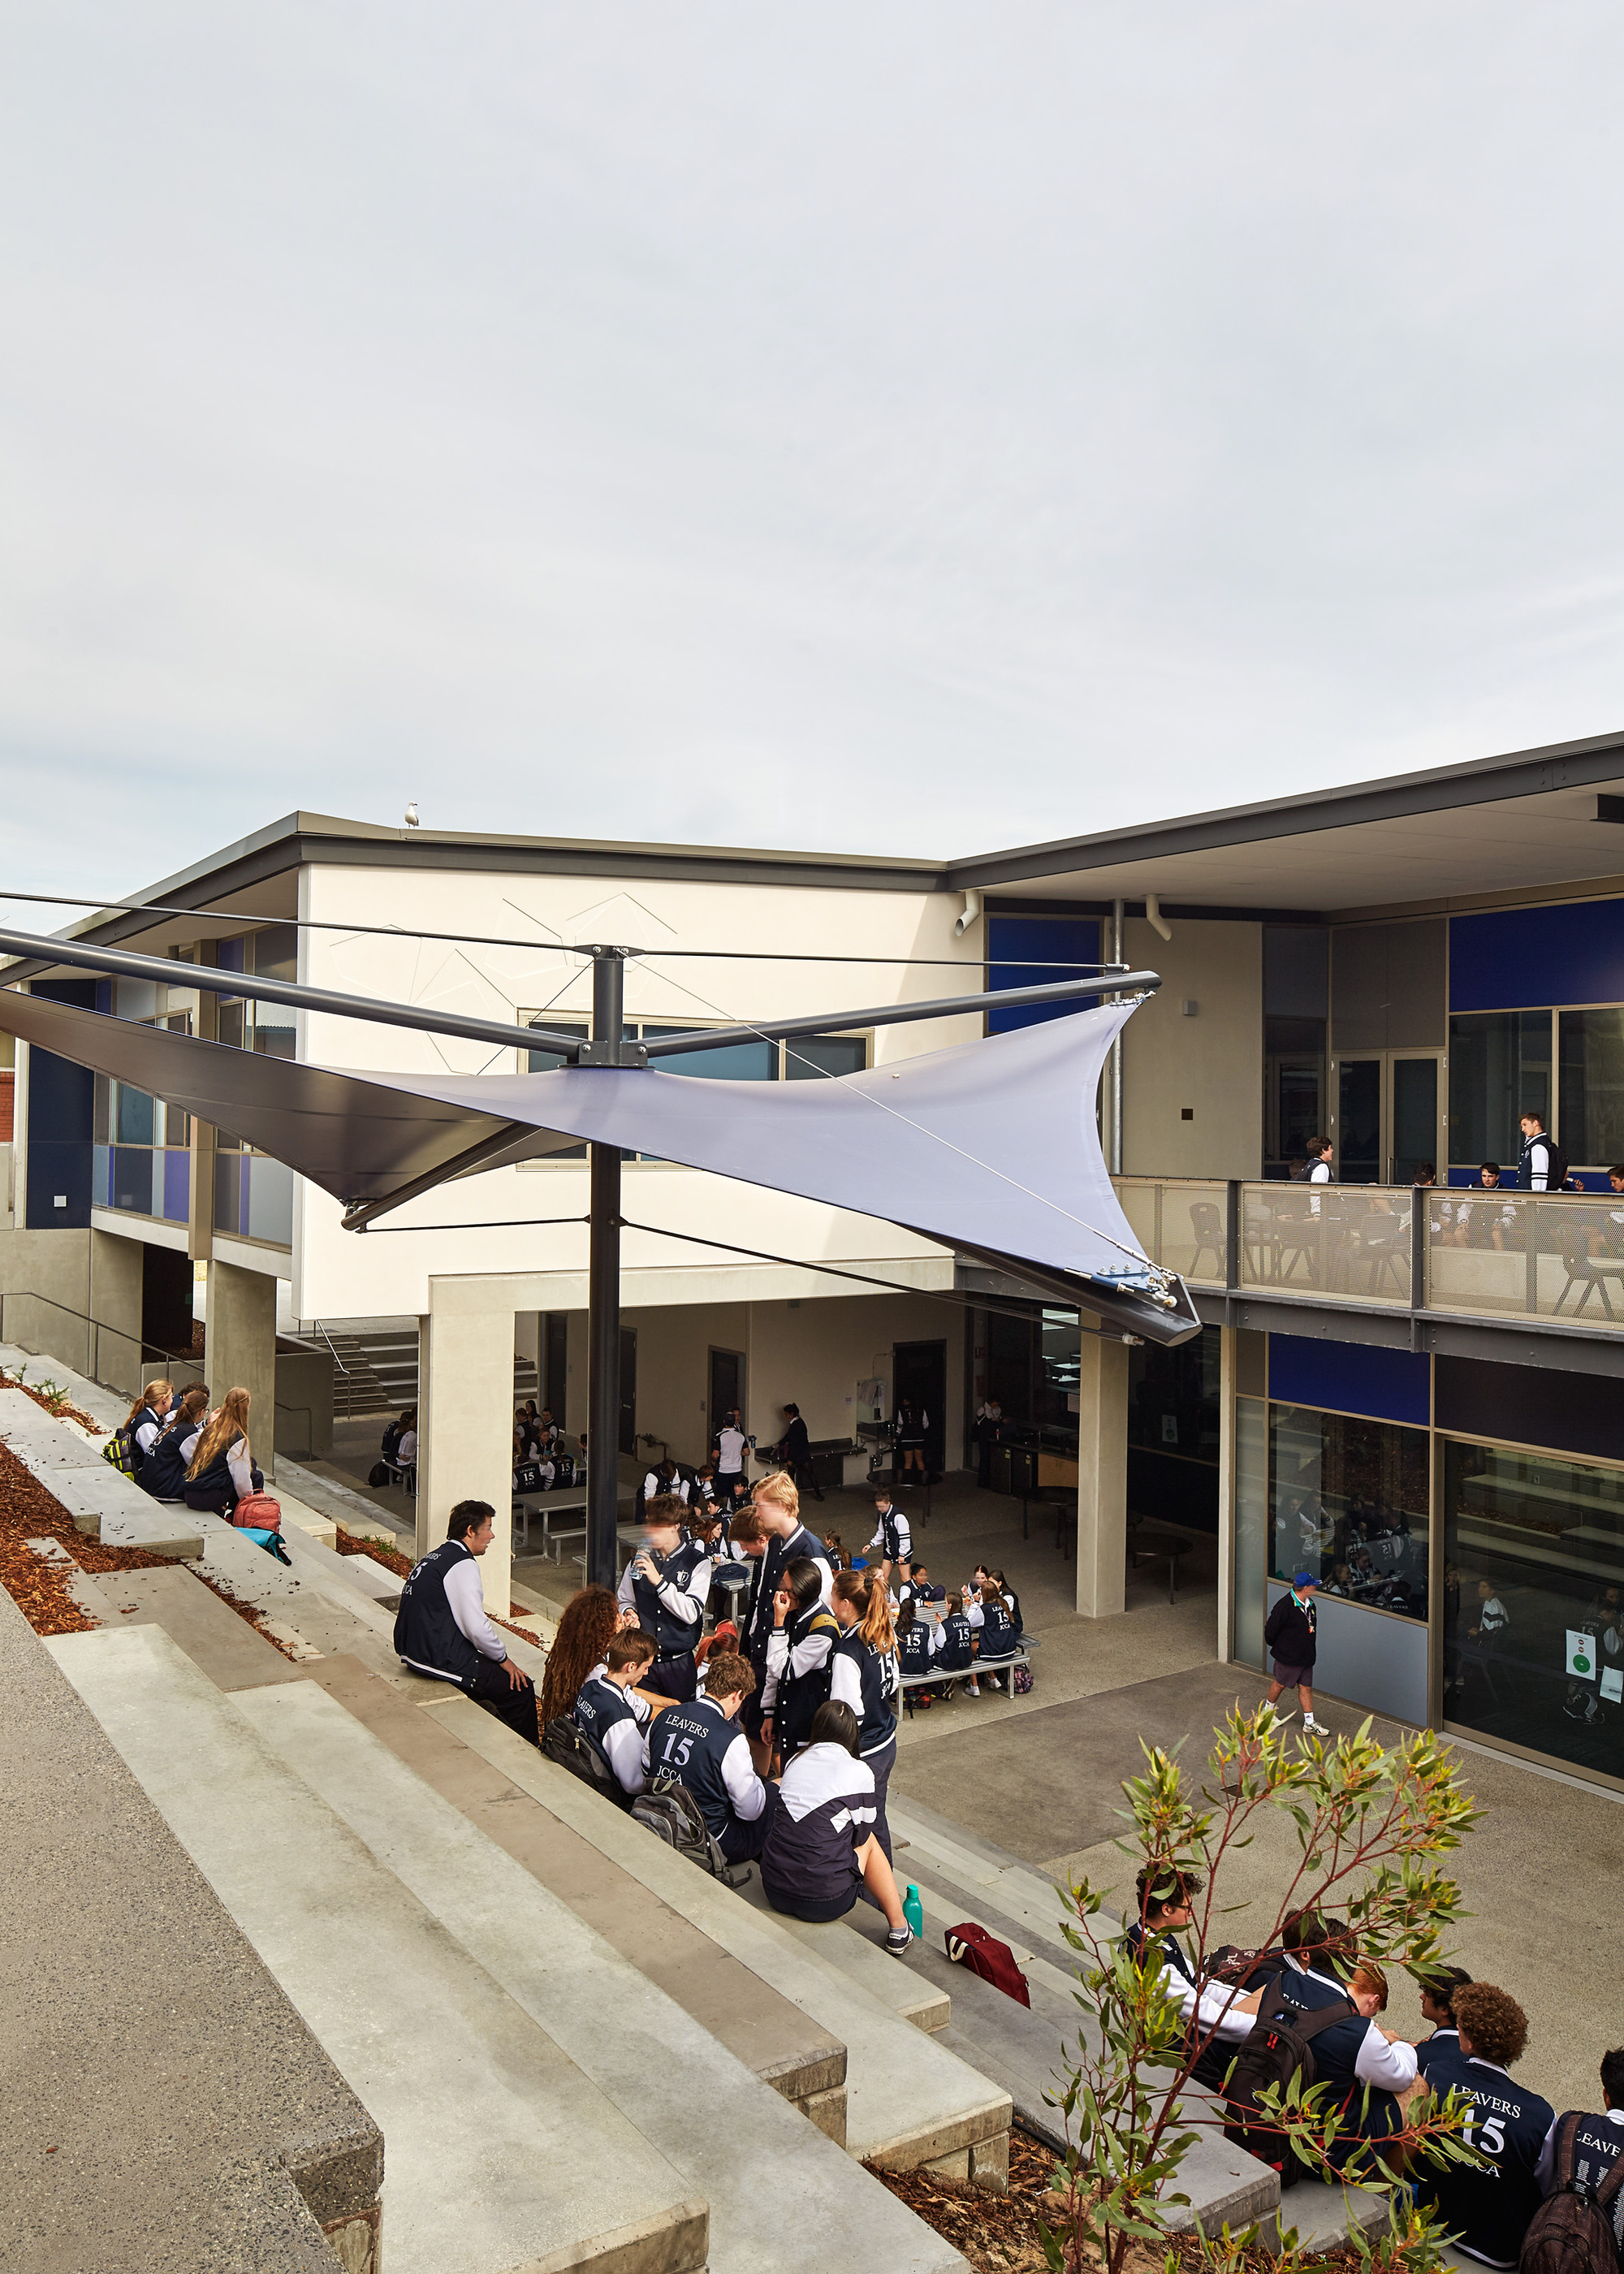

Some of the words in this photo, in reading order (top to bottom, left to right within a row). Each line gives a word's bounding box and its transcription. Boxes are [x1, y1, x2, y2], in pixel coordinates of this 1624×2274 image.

[523, 1472, 535, 1482] 15
[561, 1463, 571, 1472] 15
[408, 1562, 428, 1580] 5
[997, 1611, 1009, 1624] 15
[905, 1634, 922, 1646] 15
[958, 1628, 970, 1641] 15
[878, 1651, 893, 1684] 15
[665, 1714, 710, 1738] LEAVERS
[660, 1732, 695, 1766] 15
[656, 1765, 683, 1786] JCCA
[1452, 2082, 1521, 2119] LEAVERS
[1462, 2108, 1506, 2154] 15
